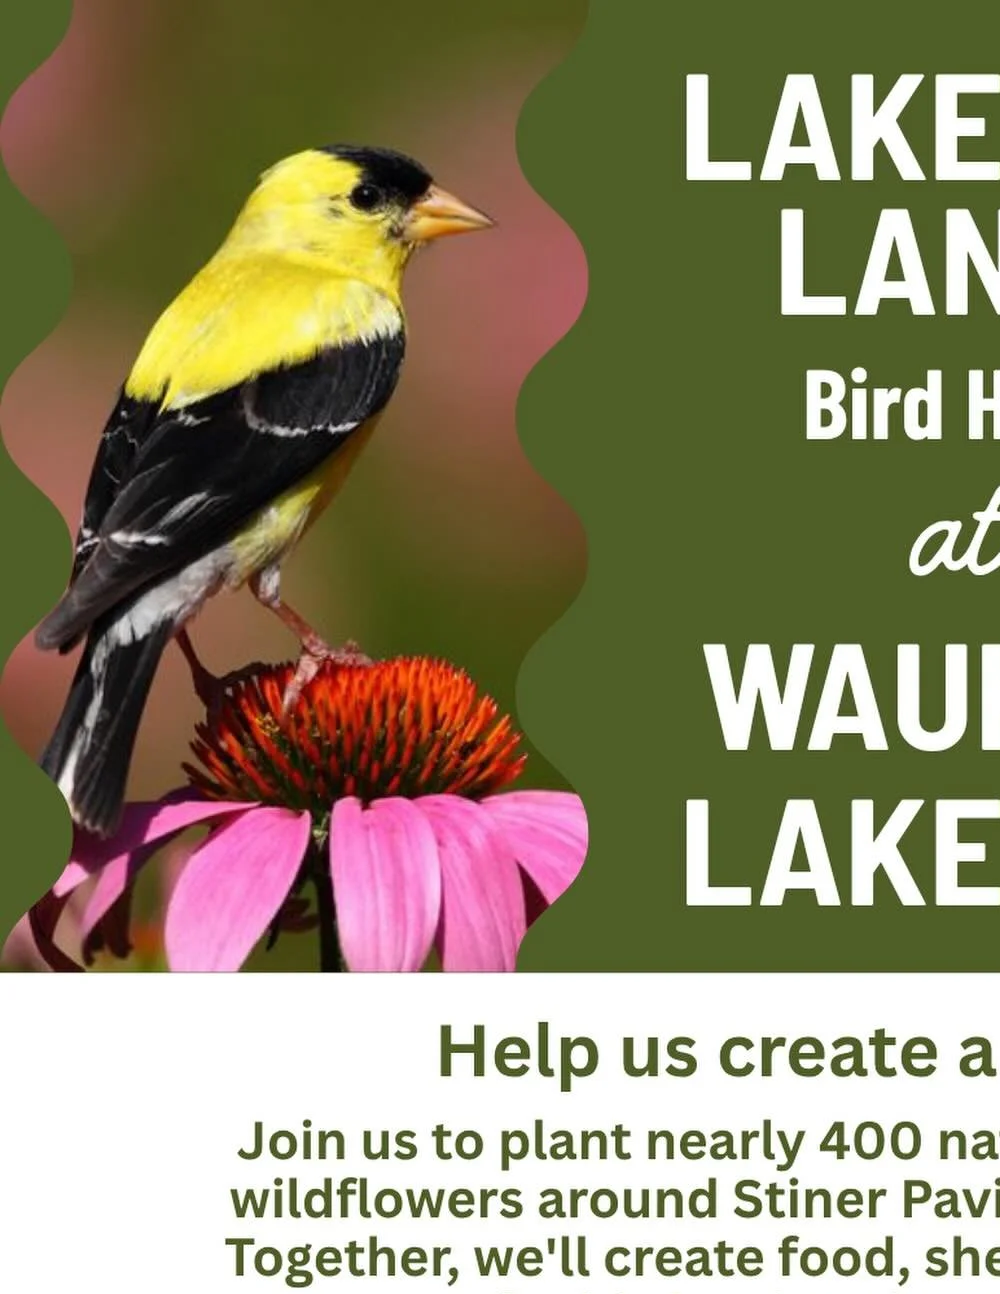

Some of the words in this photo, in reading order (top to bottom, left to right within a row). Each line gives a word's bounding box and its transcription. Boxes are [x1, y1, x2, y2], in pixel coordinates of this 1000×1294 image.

[806, 367, 942, 440] Bird
[440, 1022, 599, 1092] Help
[623, 1036, 697, 1077] us
[720, 1028, 937, 1077] create
[960, 1036, 997, 1077] a
[238, 1119, 345, 1160] Join
[363, 1130, 417, 1160] us
[432, 1124, 483, 1160] to
[501, 1119, 631, 1172] plant
[648, 1119, 805, 1172] nearly
[820, 1121, 921, 1160] 400
[230, 1177, 523, 1218] wildflowers
[539, 1178, 716, 1218] around
[734, 1177, 887, 1218] Stiner
[225, 1236, 458, 1288] Together,
[474, 1236, 590, 1277] we'll
[605, 1241, 763, 1277] create
[778, 1235, 909, 1286] food,
